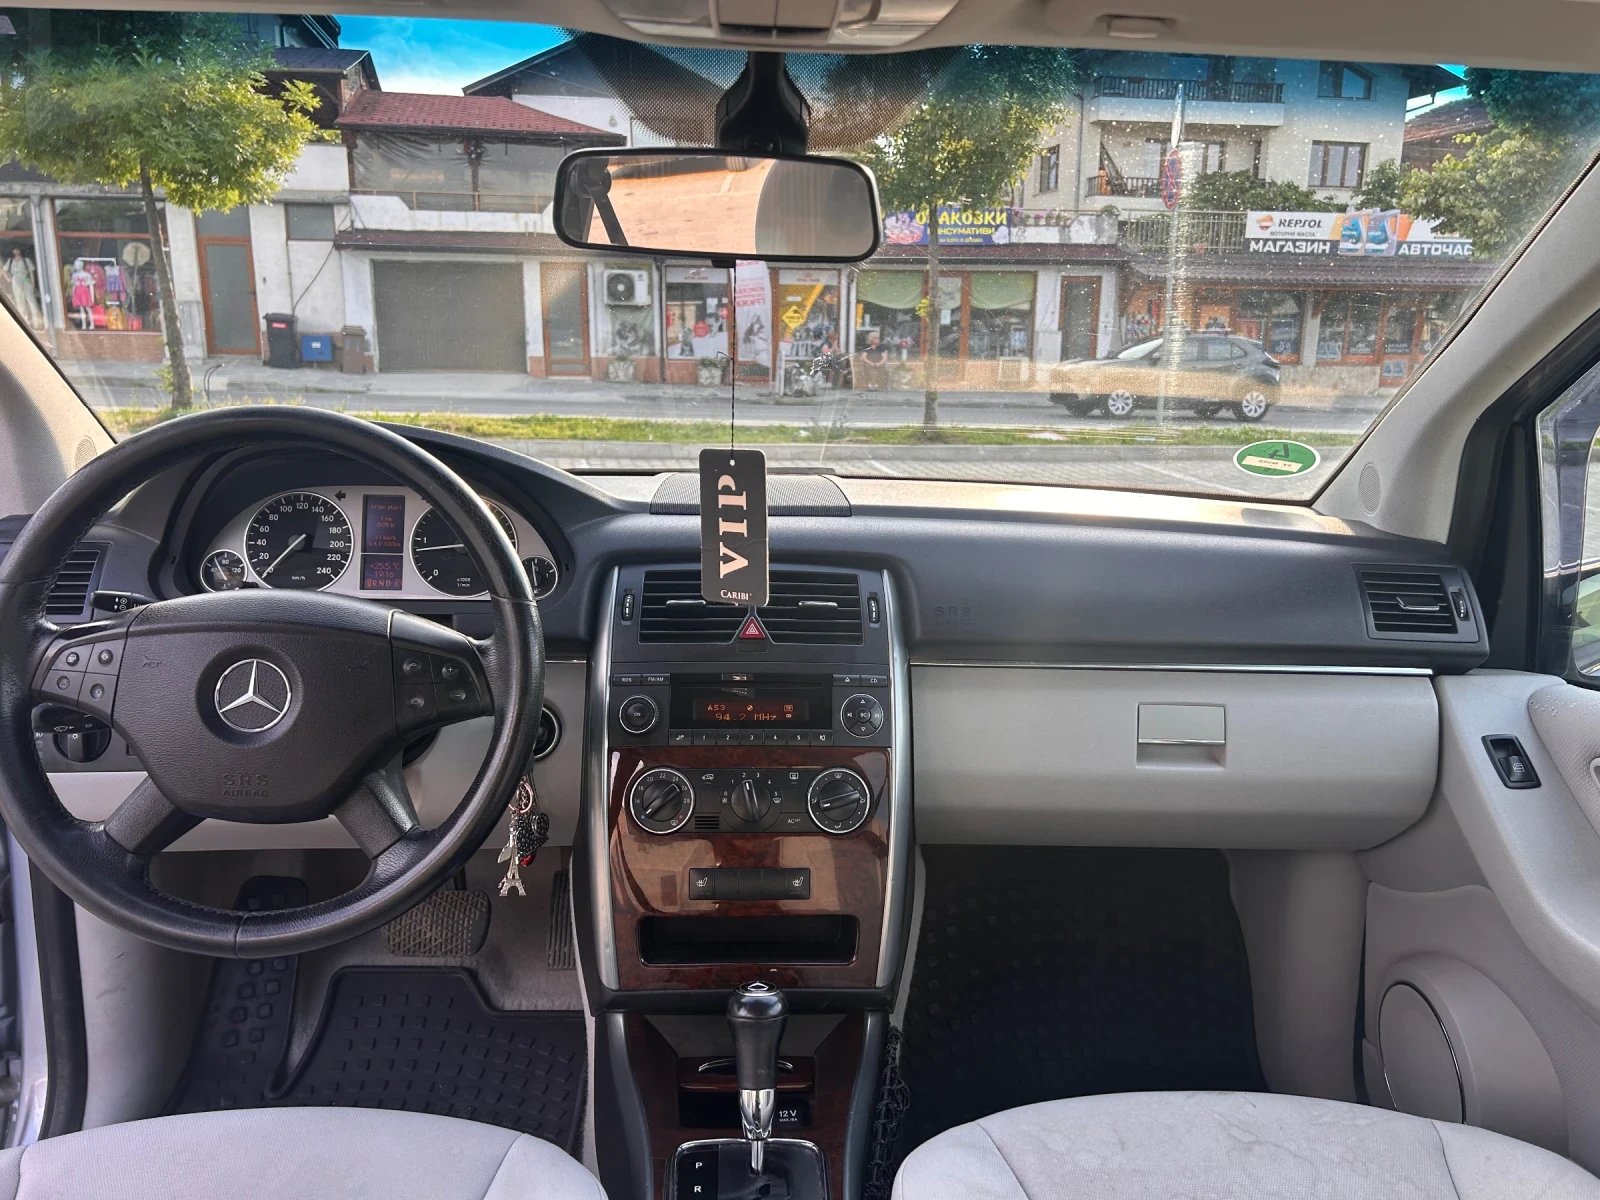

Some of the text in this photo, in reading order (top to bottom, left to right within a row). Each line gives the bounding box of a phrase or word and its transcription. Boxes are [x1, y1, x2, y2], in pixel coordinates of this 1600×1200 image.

[915, 211, 1007, 225] ОАКОВКИ
[1278, 218, 1322, 228] REPSOL
[927, 227, 995, 235] НСУМАТИВИ
[1249, 240, 1331, 254] МАГАЗИН
[717, 474, 749, 579] VIP
[223, 774, 268, 786] SRS
[779, 1109, 797, 1118] 12 V
[694, 1185, 702, 1193] R
